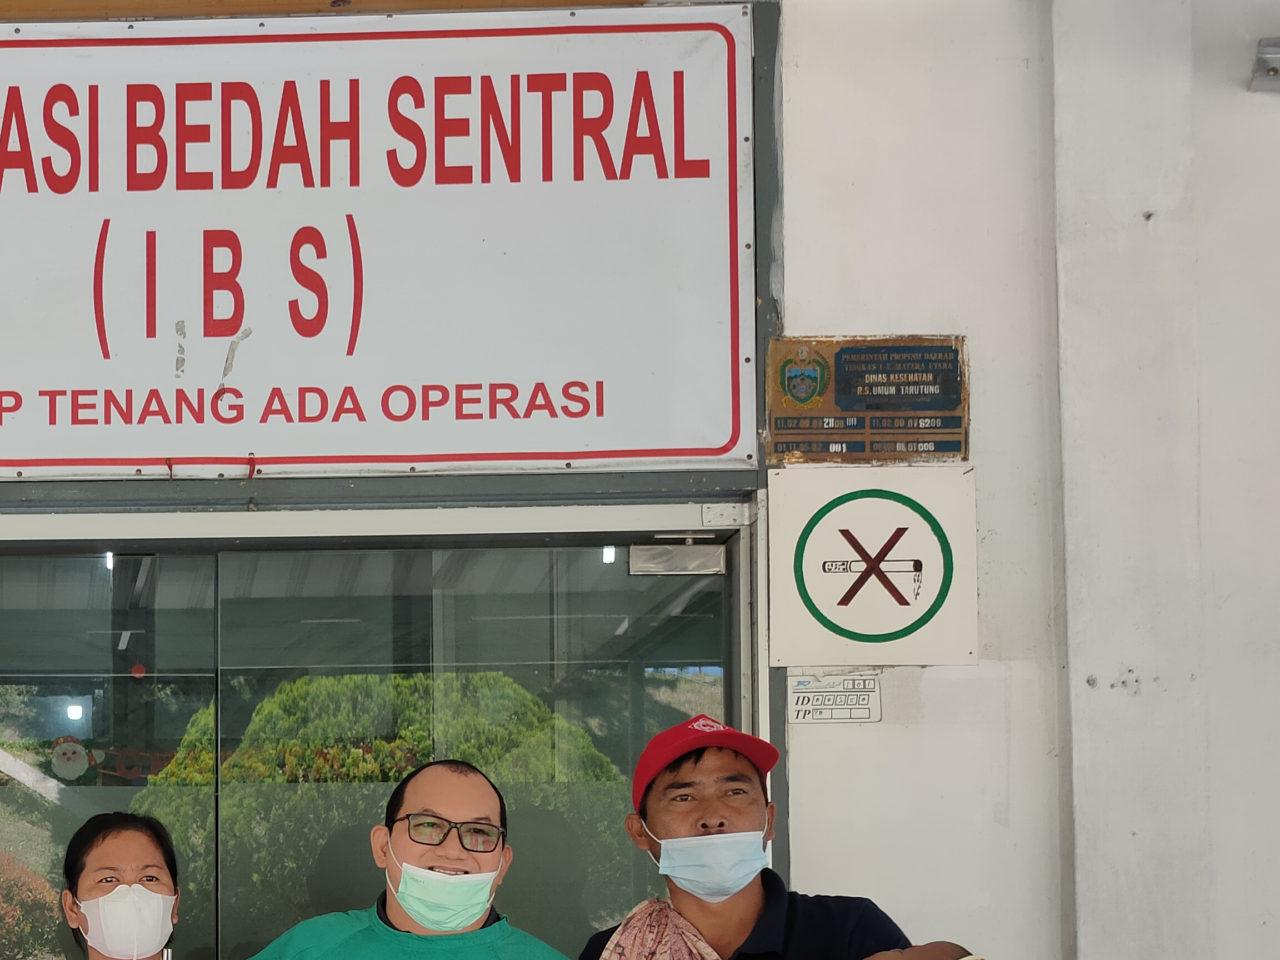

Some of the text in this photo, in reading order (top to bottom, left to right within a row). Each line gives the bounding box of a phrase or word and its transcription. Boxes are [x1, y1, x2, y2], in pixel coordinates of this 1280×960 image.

[126, 78, 361, 193] BEDAH
[386, 70, 711, 188] SENTRAL
[865, 373, 933, 383] DINAS KESEHATAN
[900, 385, 940, 395] TARUTUNG
[38, 387, 245, 426] TENANG
[259, 385, 367, 424] ADA
[380, 380, 604, 423] OPERASI
[795, 695, 811, 706] ID
[794, 709, 811, 720] TP
